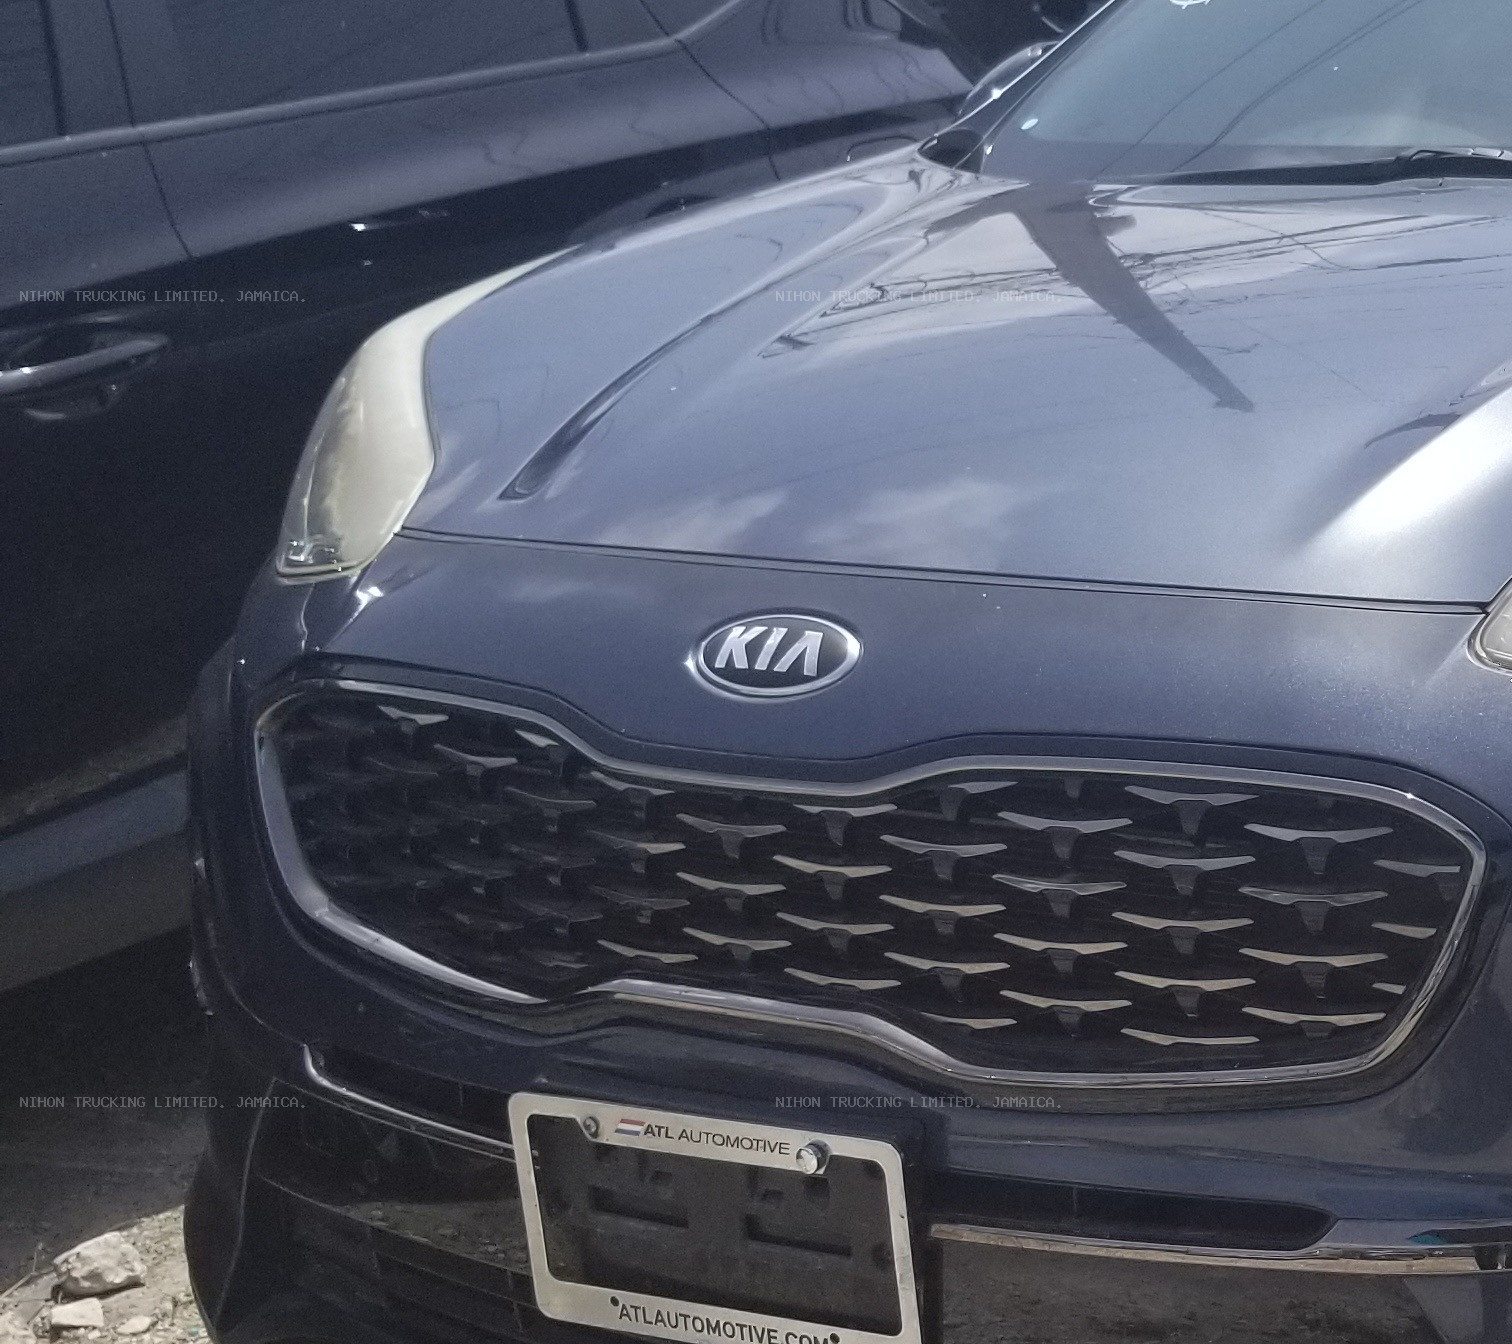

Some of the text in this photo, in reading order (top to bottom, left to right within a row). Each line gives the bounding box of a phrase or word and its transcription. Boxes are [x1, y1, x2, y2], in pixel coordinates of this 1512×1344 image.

[714, 625, 824, 677] KIA
[643, 1123, 791, 1157] ATL AUTOMOTIVE
